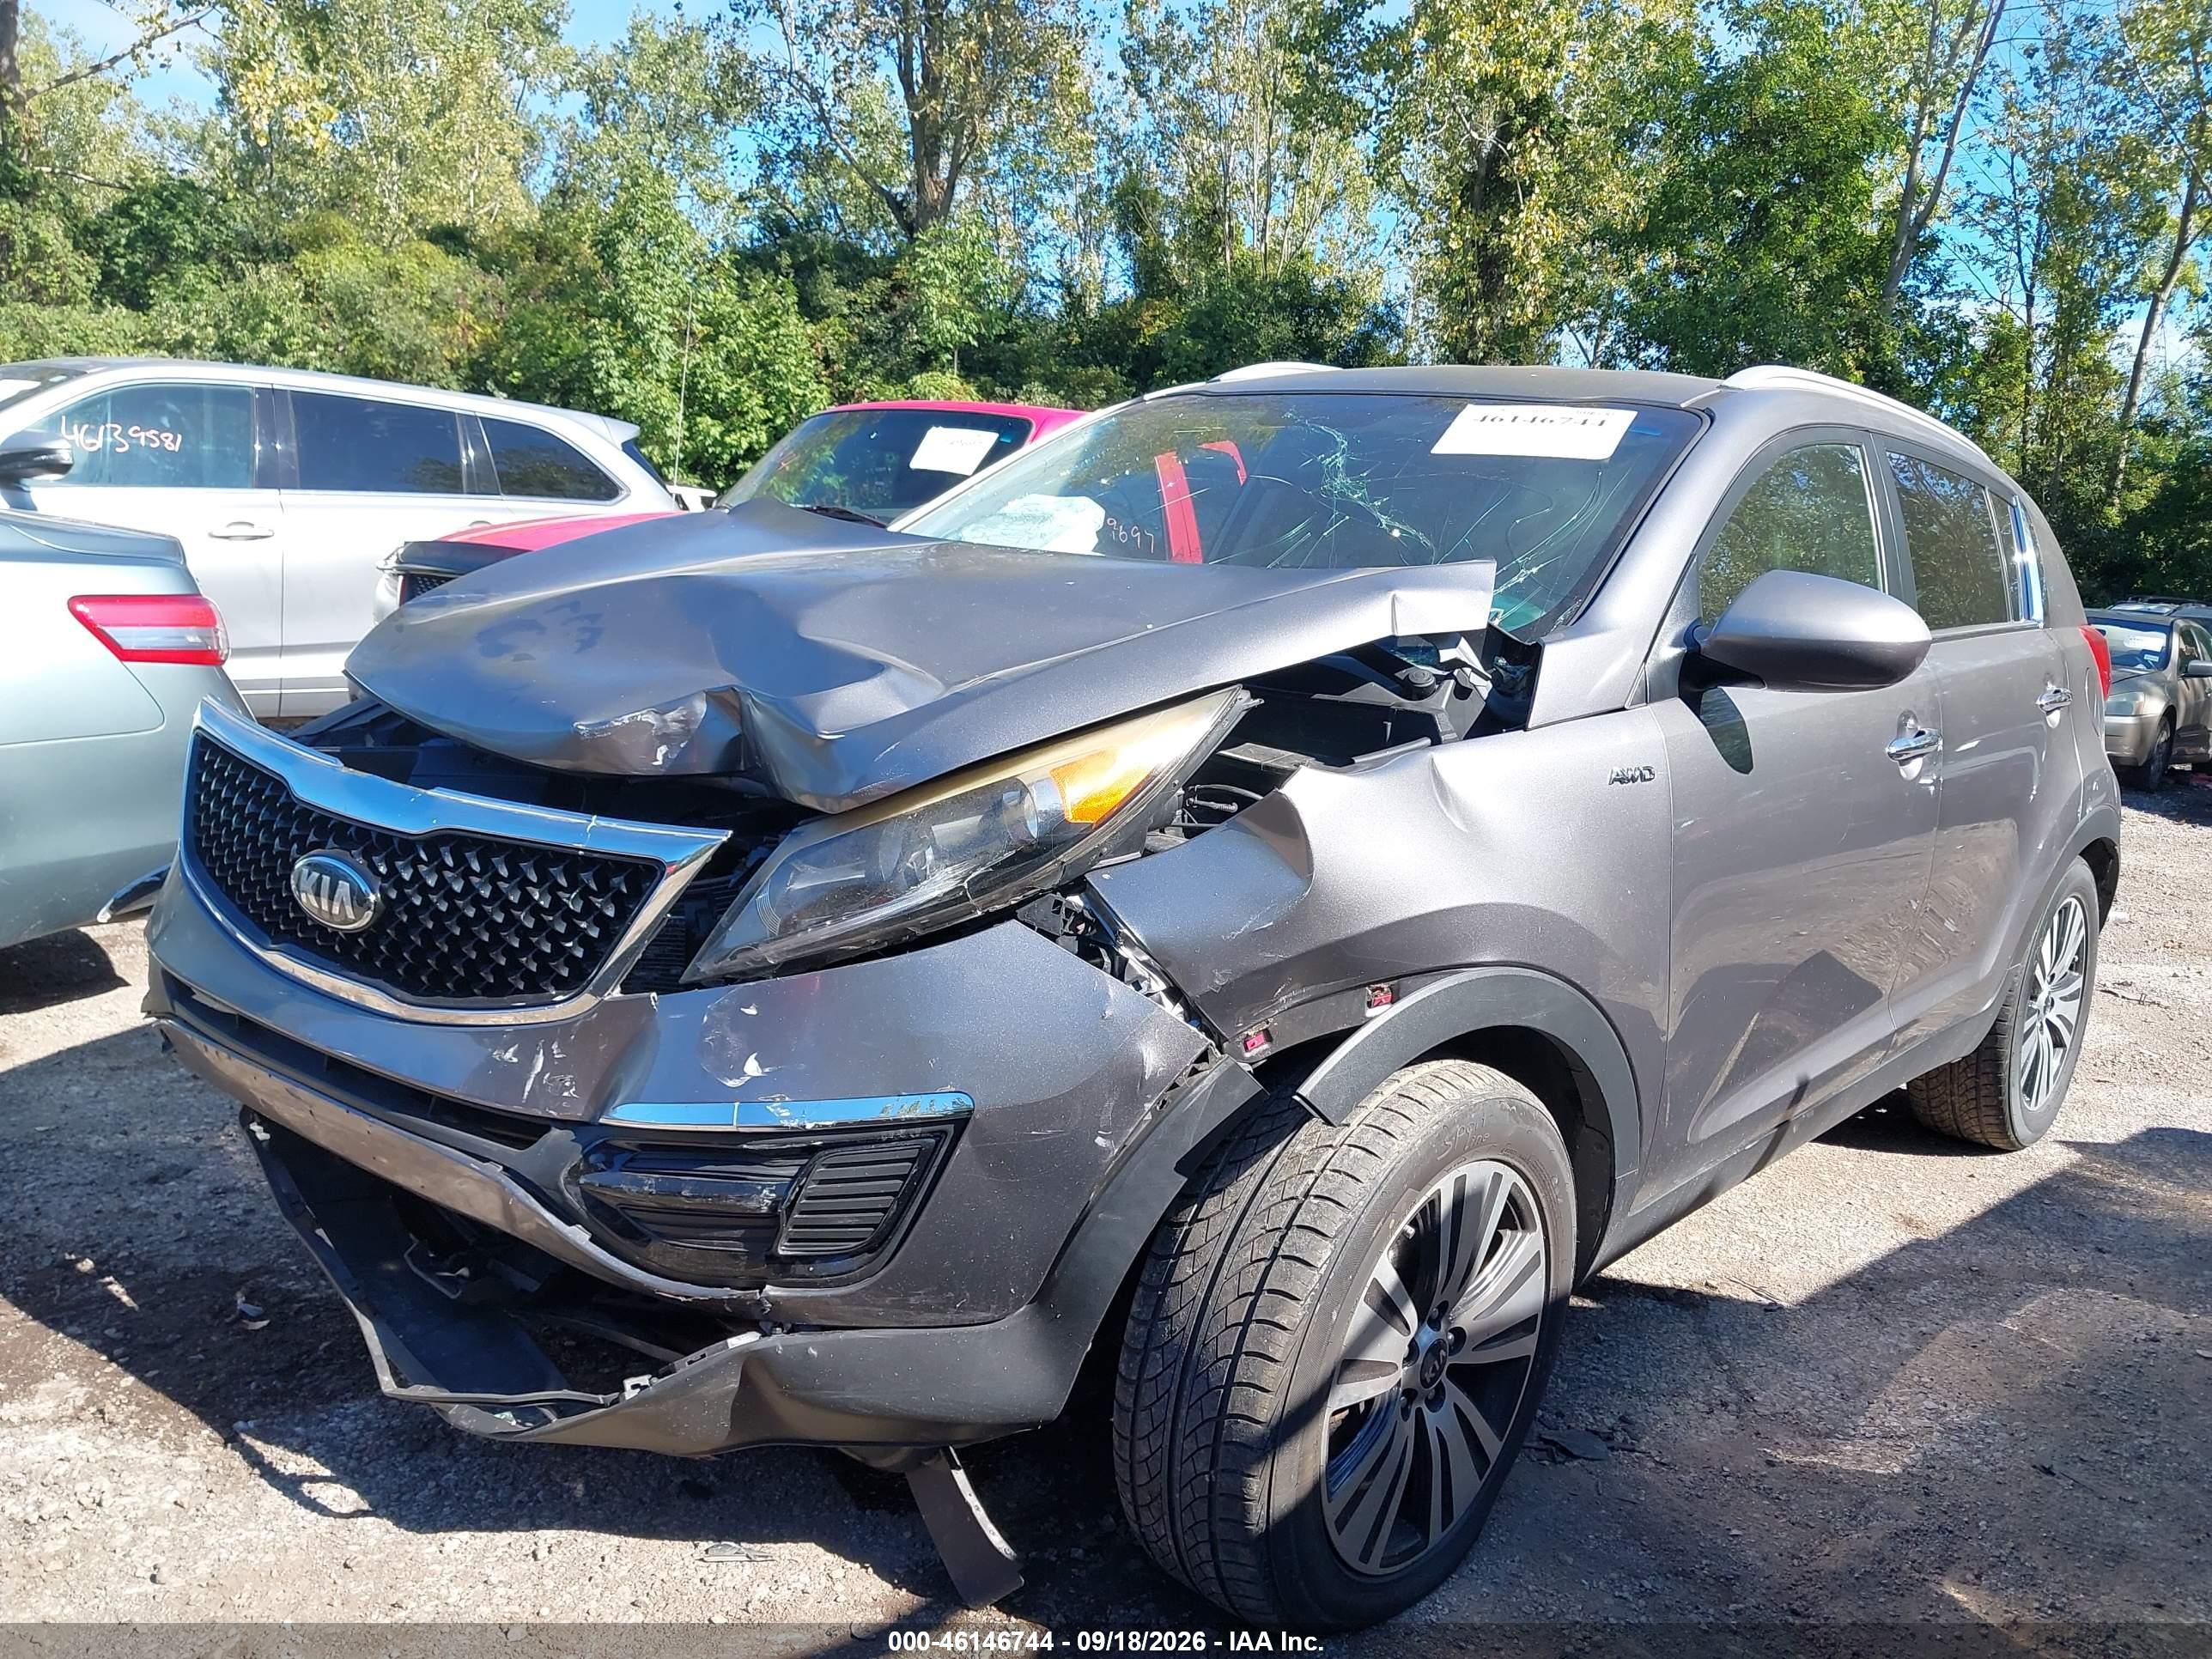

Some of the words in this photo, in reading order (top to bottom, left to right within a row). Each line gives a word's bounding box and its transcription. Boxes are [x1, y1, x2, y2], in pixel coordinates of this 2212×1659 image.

[61, 415, 183, 454] 46139581
[1607, 765, 1656, 786] AWD
[300, 867, 356, 921] KIA
[1424, 1348, 1447, 1384] KIA
